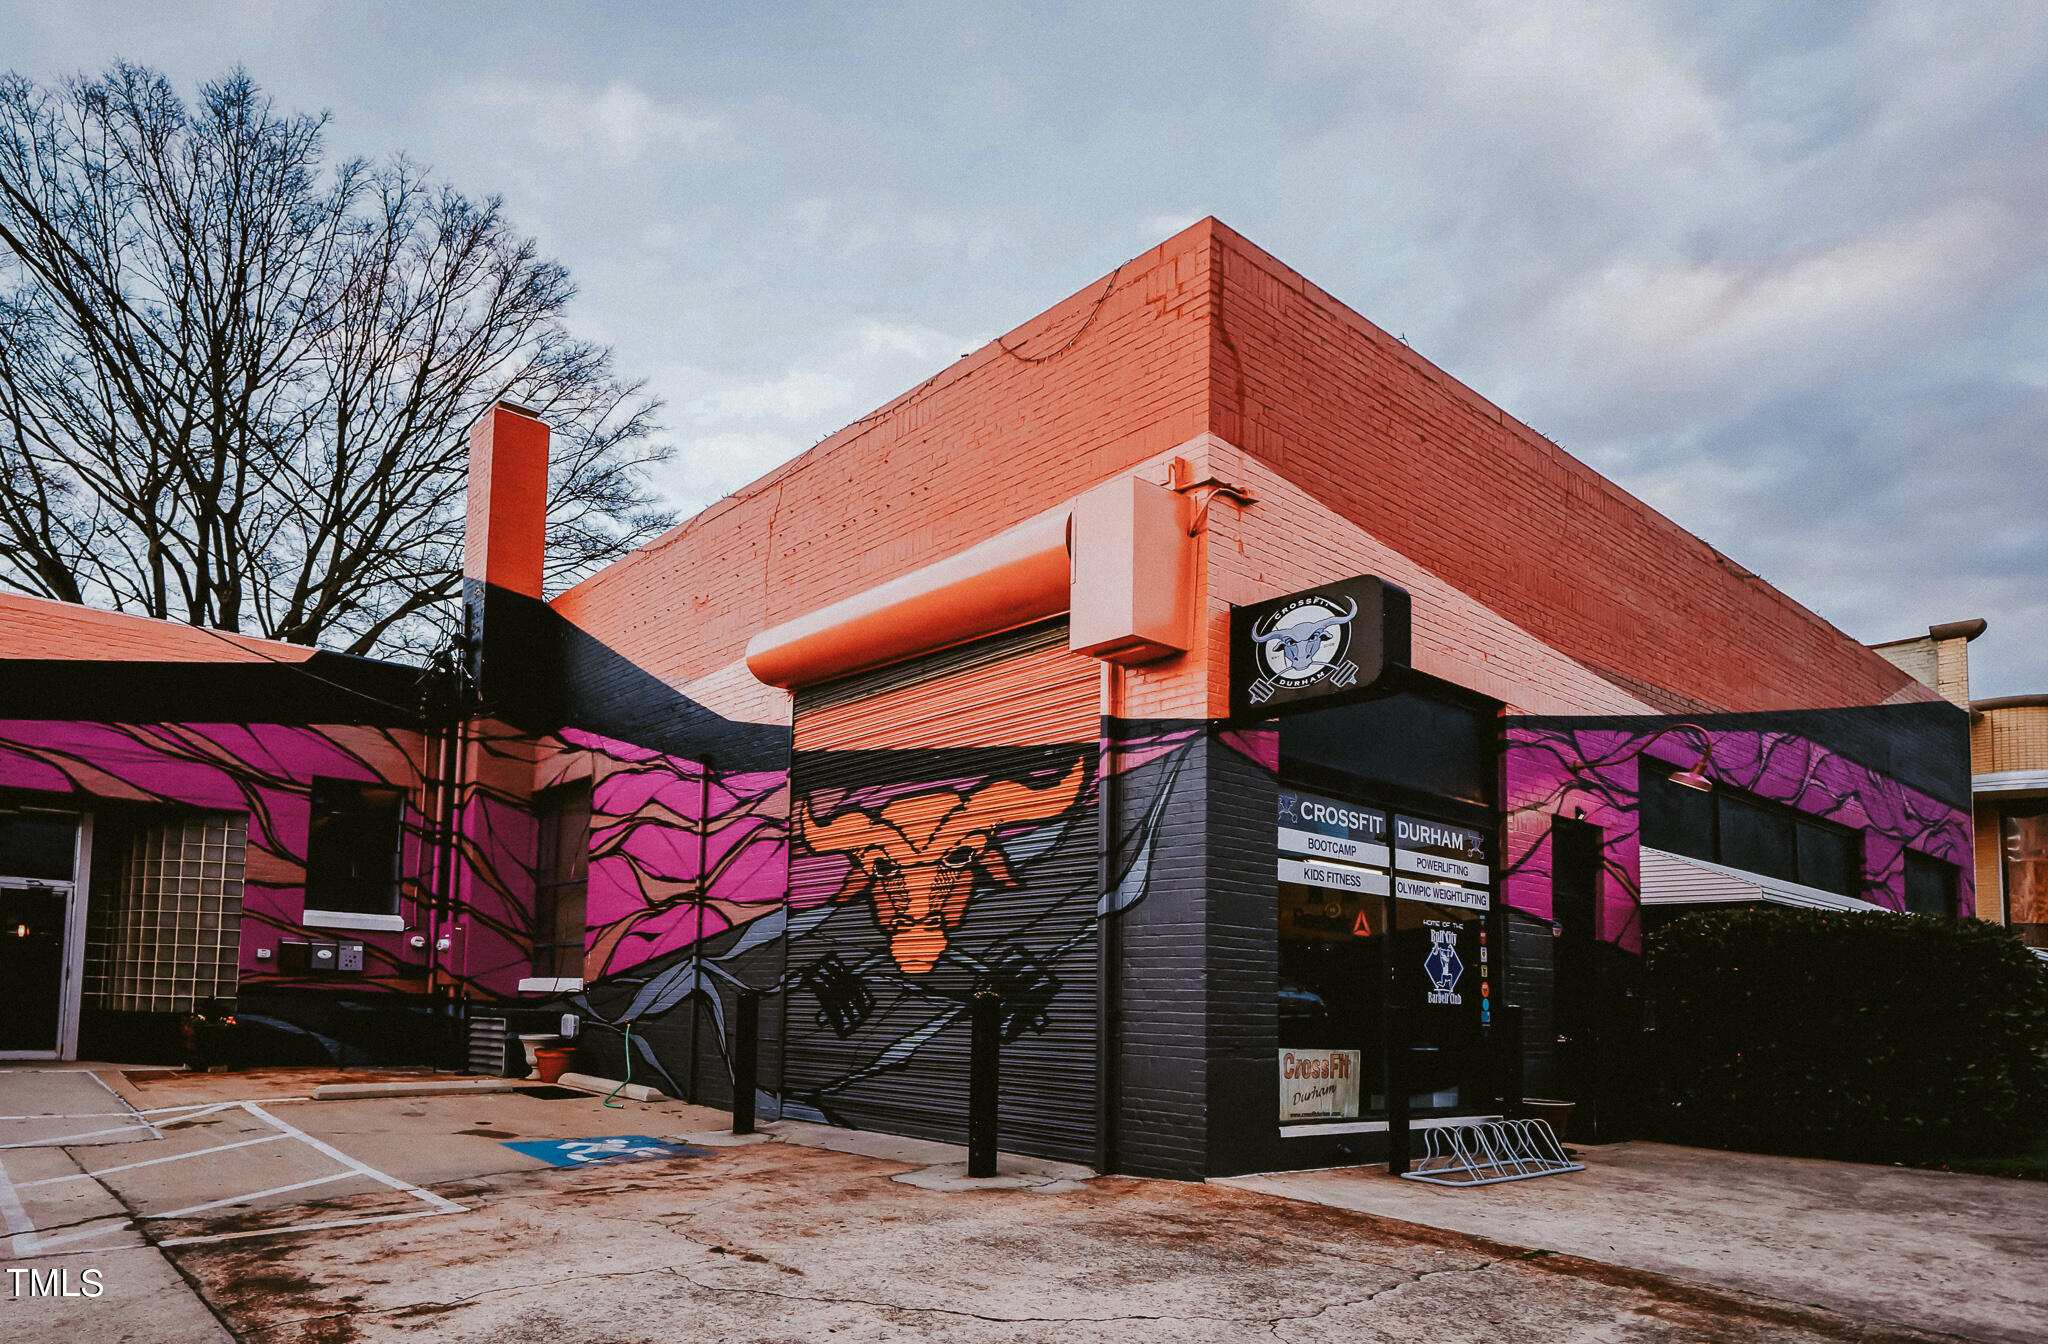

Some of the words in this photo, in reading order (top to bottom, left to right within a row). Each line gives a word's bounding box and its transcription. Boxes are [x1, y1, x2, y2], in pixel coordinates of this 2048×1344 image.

[1275, 598, 1329, 620] CROSSFIT
[1279, 671, 1325, 686] DURHAM
[1300, 802, 1383, 833] CROSSFIT
[1398, 821, 1464, 850] DURHAM
[1308, 838, 1357, 857] BOOTCAMP
[1304, 868, 1325, 881] KIDS
[1326, 871, 1361, 887] FITNESS
[1416, 857, 1469, 877] POWERLIFTING
[1397, 882, 1431, 898] OLYMPIC
[1432, 888, 1487, 906] WEIGHTLIFTING
[1283, 1052, 1350, 1079] CrossFit
[1293, 1084, 1337, 1106] Durham
